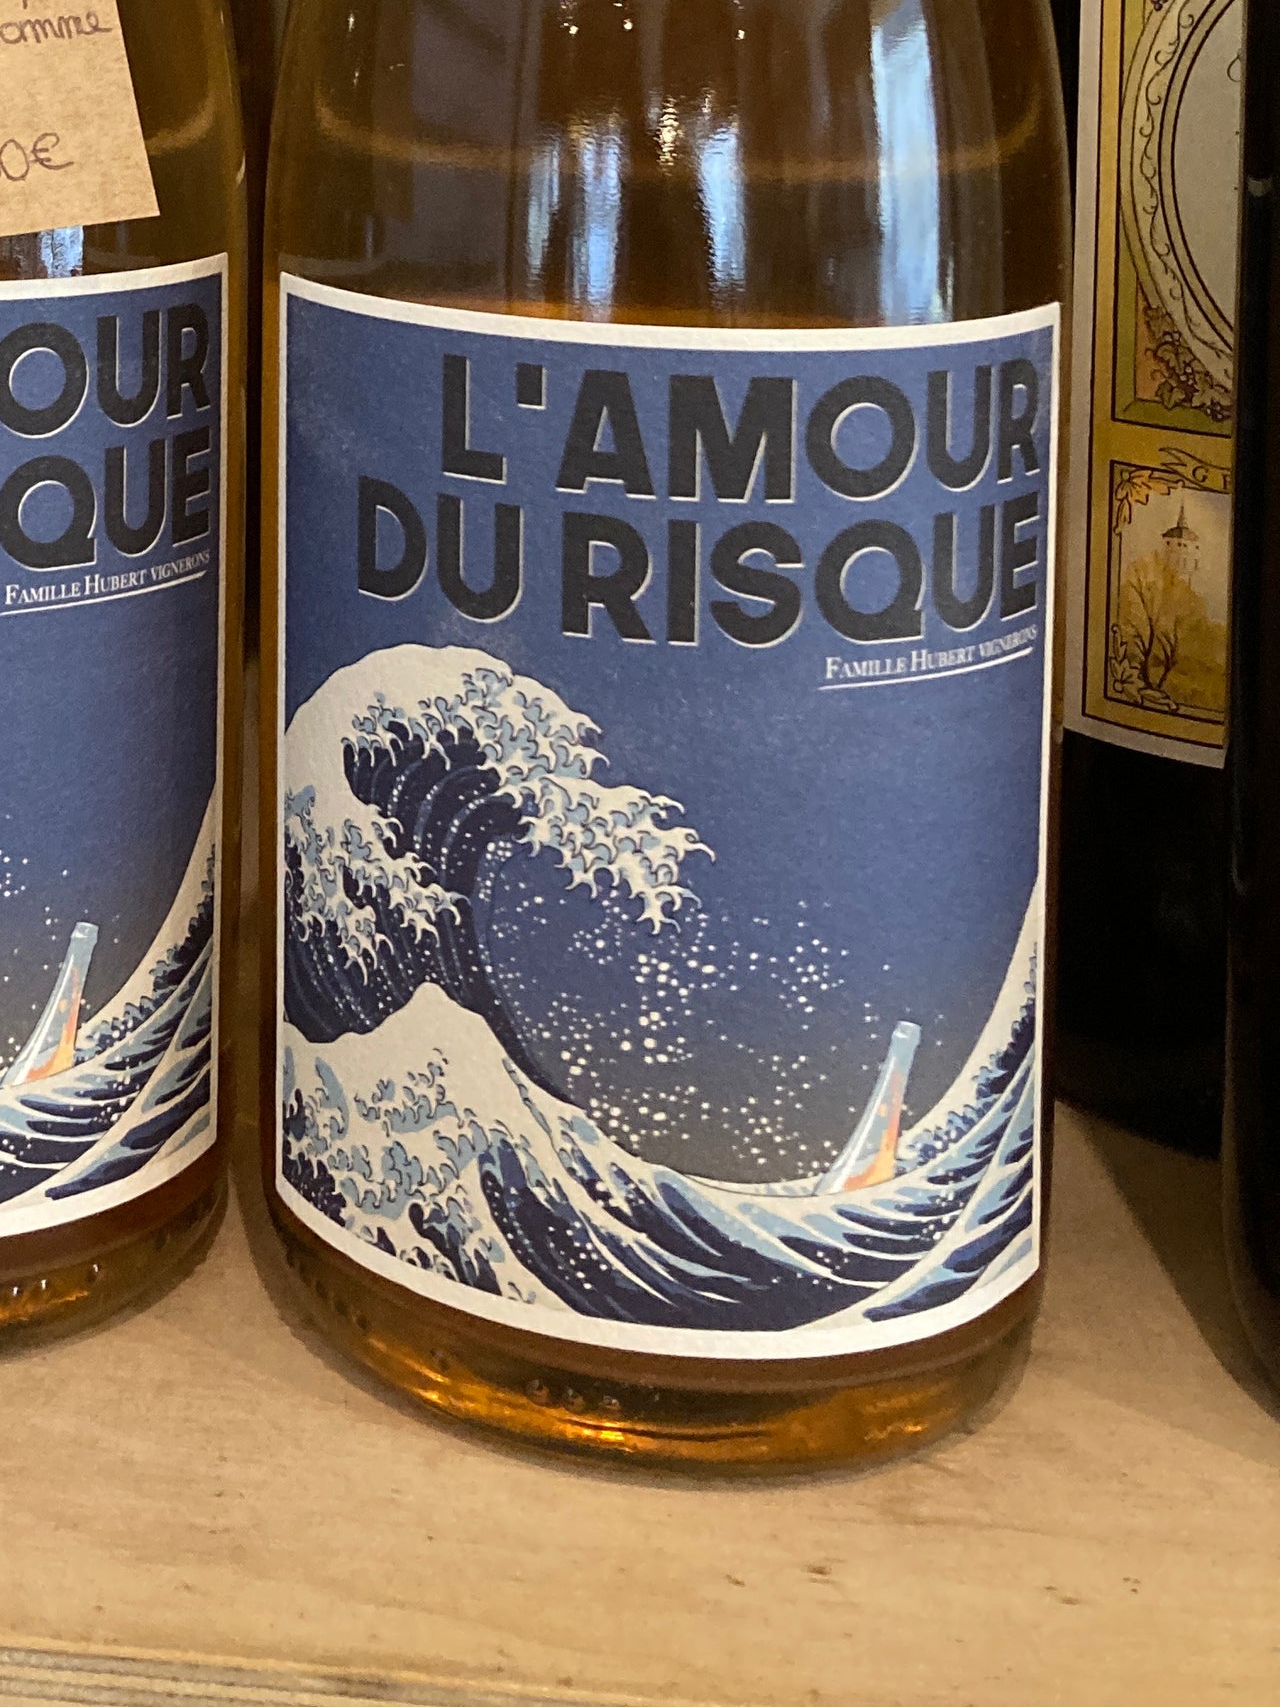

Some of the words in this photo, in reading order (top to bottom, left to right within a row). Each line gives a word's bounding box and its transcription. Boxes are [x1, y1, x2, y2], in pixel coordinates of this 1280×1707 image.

[440, 356, 1041, 505] L'AMOUR
[357, 475, 523, 624] DU
[560, 489, 1041, 648] RISQUE
